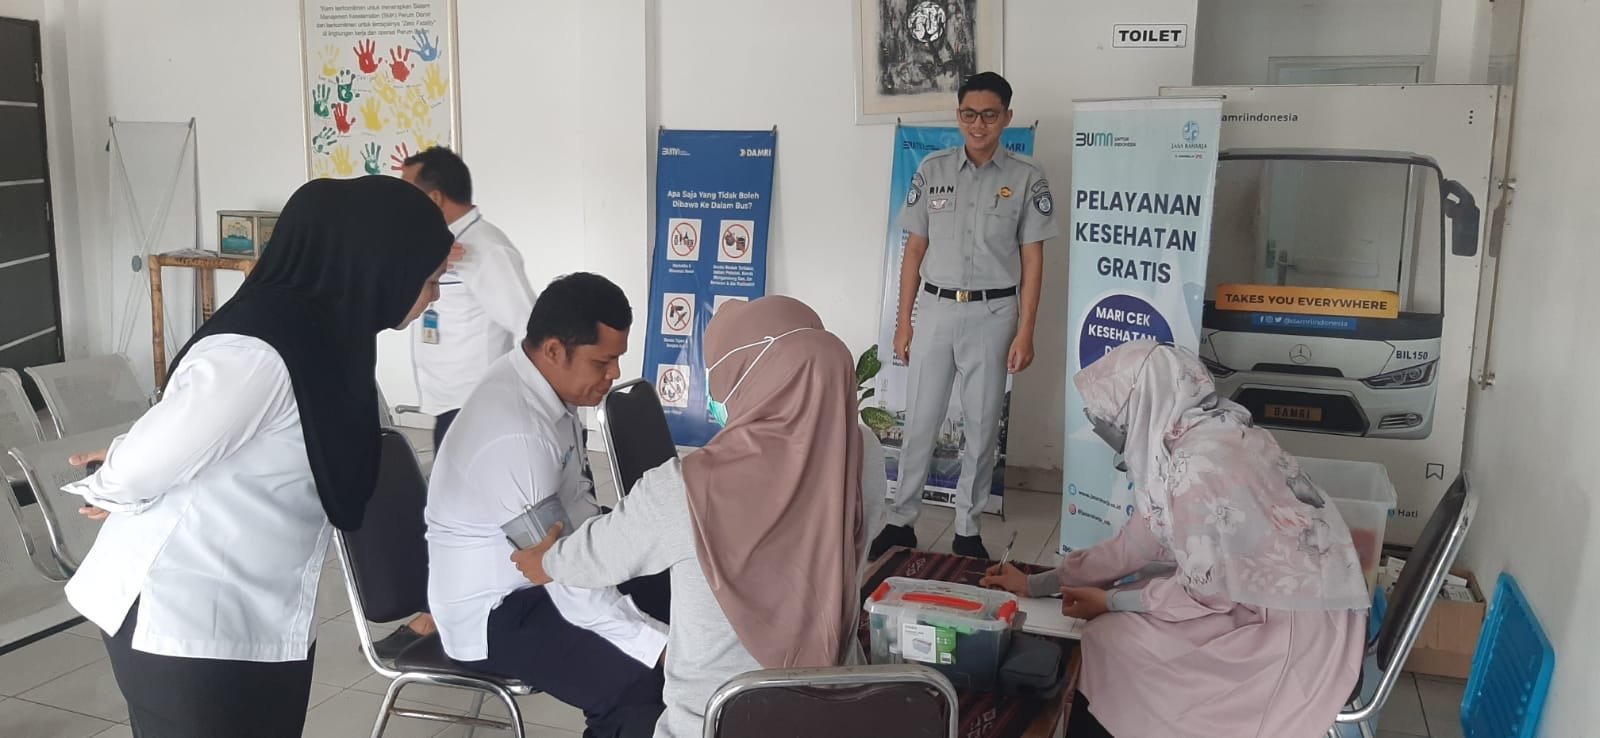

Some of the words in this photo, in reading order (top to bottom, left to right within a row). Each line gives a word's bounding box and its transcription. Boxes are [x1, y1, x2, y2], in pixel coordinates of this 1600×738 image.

[1118, 29, 1182, 42] TOILET
[1221, 112, 1298, 122] amriindonesia
[1006, 142, 1025, 152] MRI
[746, 148, 772, 157] DAMRI
[667, 190, 681, 199] Apa
[682, 190, 697, 199] Saja
[699, 191, 717, 200] Yang
[718, 191, 737, 200] Tidak
[738, 191, 760, 200] Boleh
[929, 185, 954, 195] RIAN
[672, 199, 699, 209] Dibawa
[700, 200, 710, 208] Ke
[711, 201, 734, 209] Dalam
[735, 202, 753, 210] Bus?
[1076, 189, 1201, 217] PELAYANAN
[1075, 222, 1197, 252] KESEHATAN
[1097, 256, 1172, 284] GRATIS
[1225, 293, 1265, 304] TAKES
[1268, 295, 1295, 305] YOU
[1298, 297, 1388, 311] EVERYWHERE
[1096, 306, 1125, 322] MARI
[1126, 311, 1151, 327] CEK
[1396, 350, 1429, 360] BIL150
[1397, 508, 1419, 518] Hati
